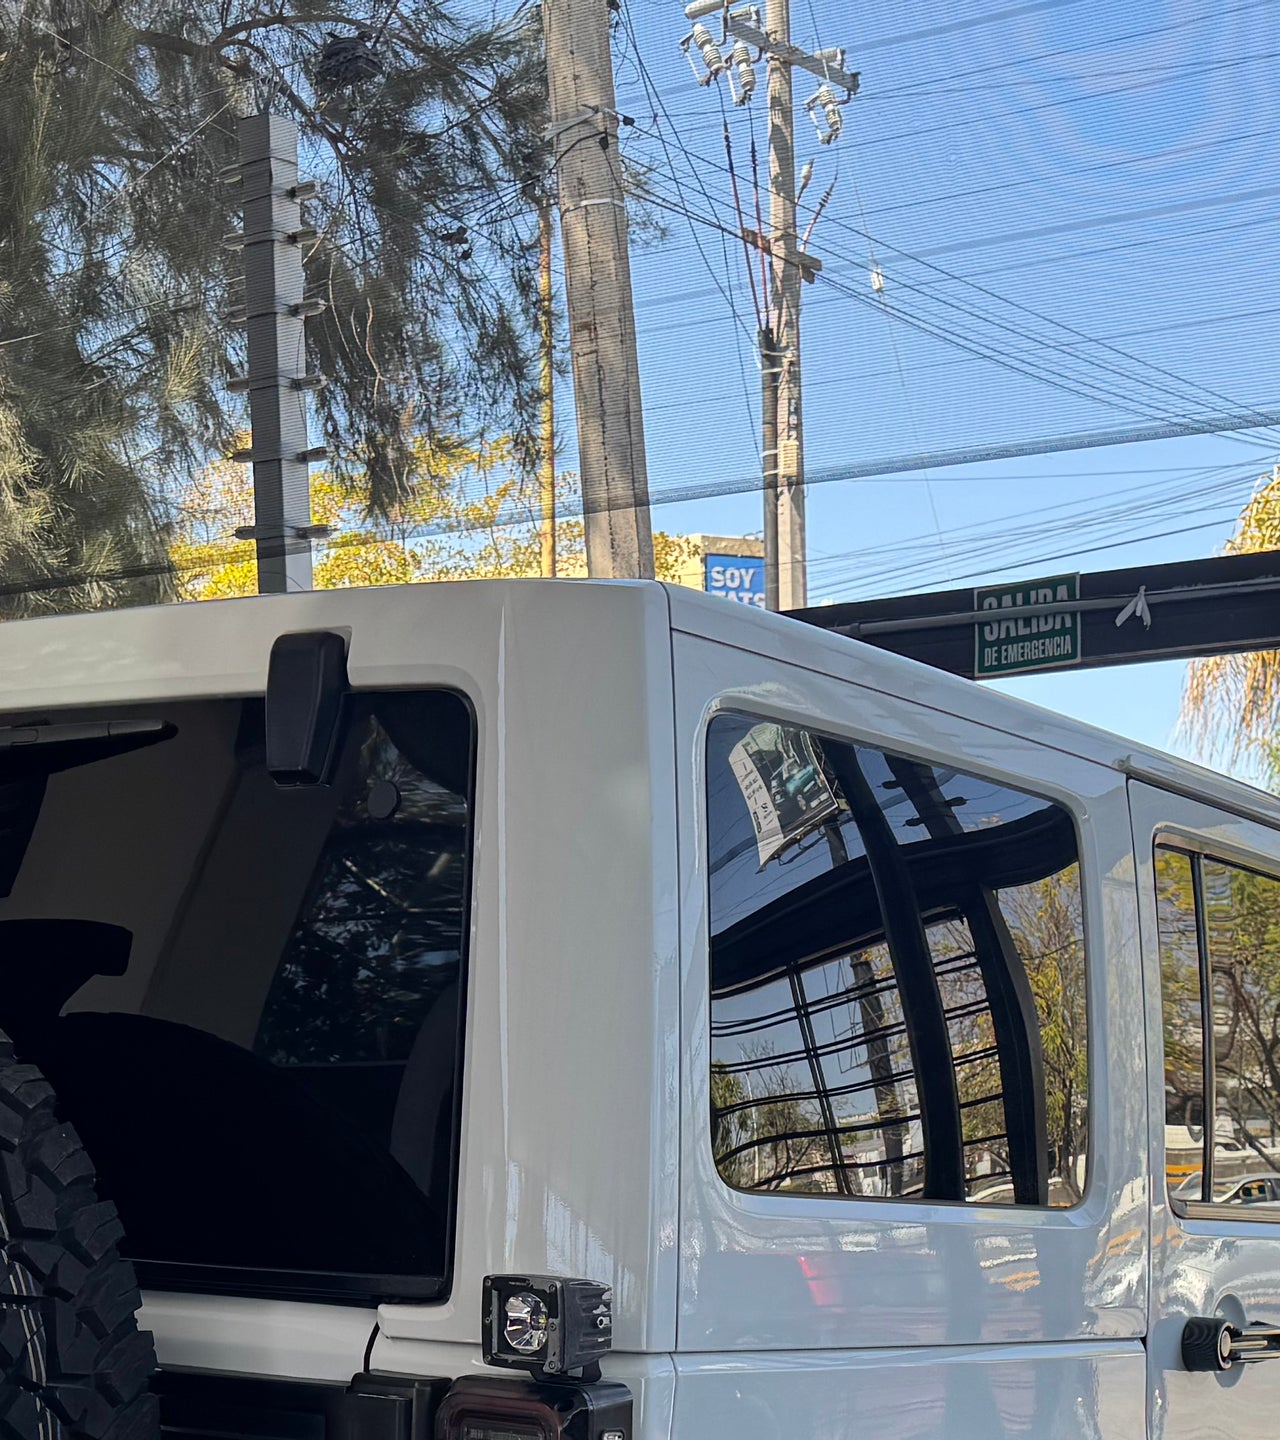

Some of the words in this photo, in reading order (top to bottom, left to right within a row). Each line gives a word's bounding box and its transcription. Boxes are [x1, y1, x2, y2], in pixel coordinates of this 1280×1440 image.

[711, 566, 755, 589] SOY
[983, 585, 1072, 641] SALIDA
[984, 646, 998, 667] DE
[1001, 635, 1072, 664] EMERGENCIA
